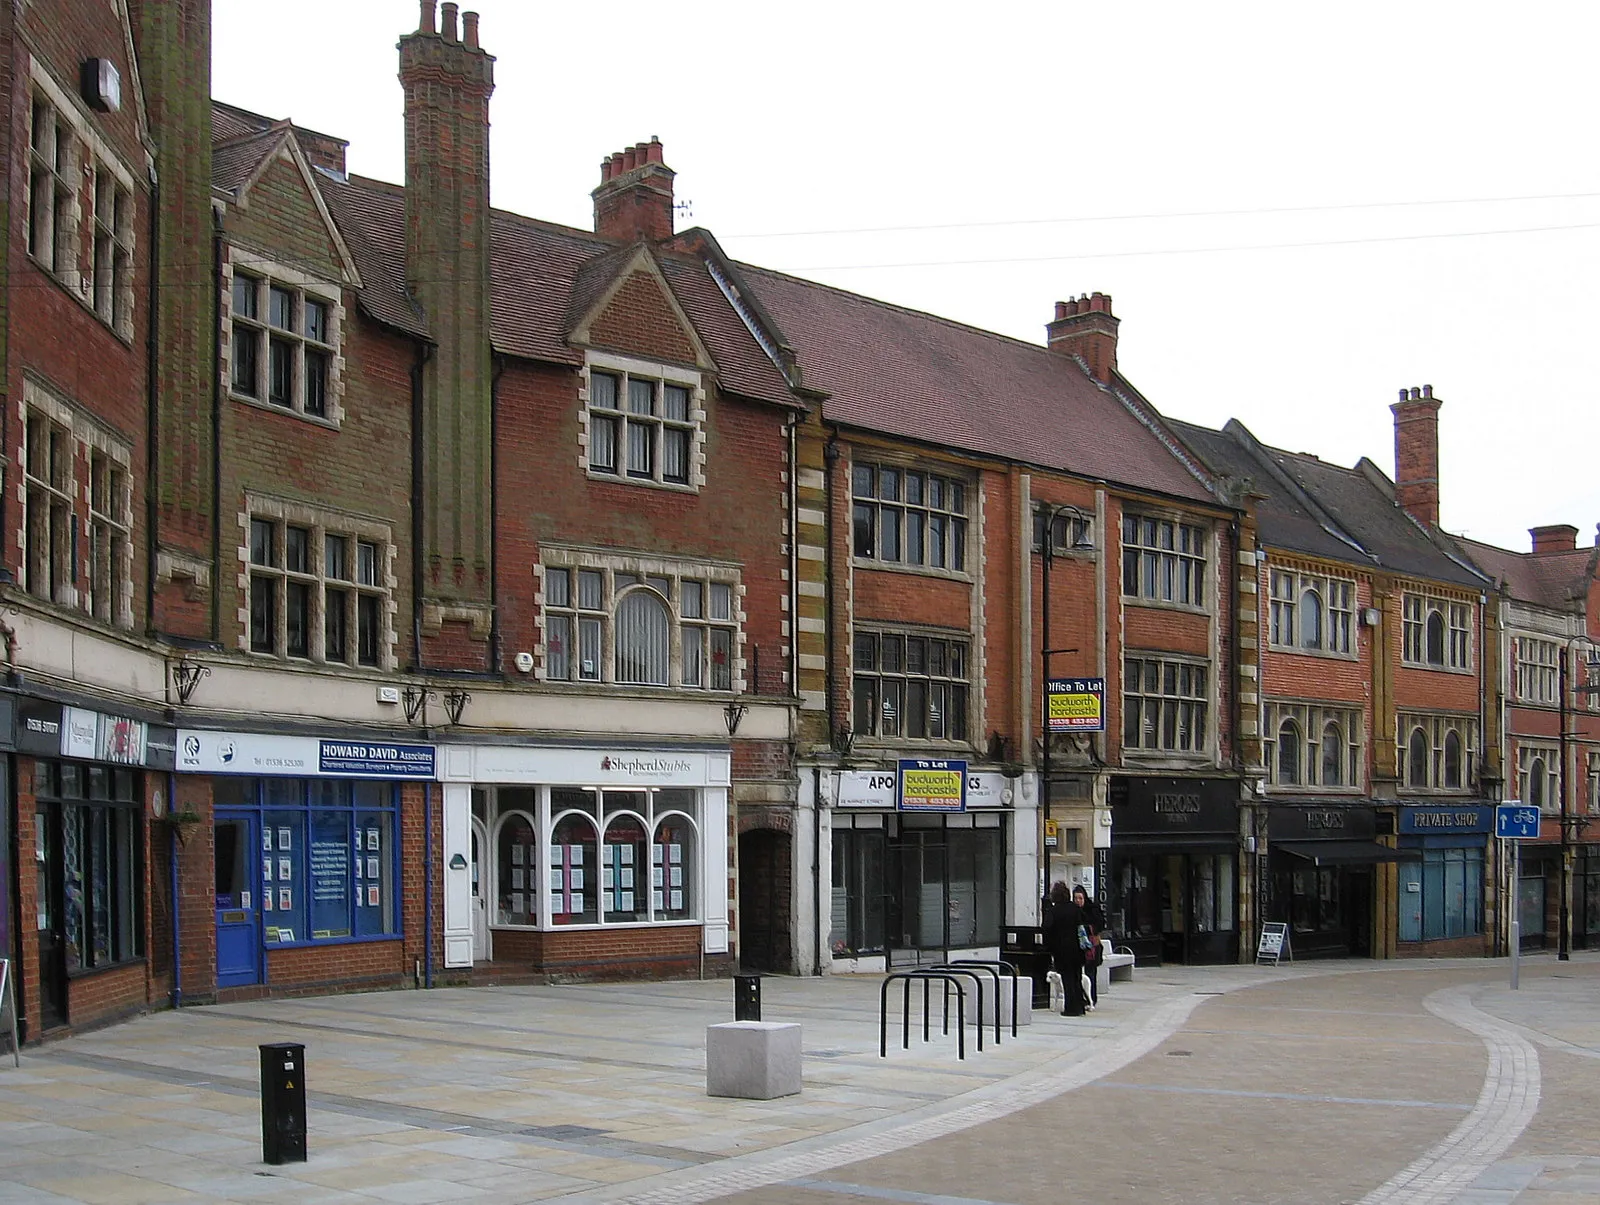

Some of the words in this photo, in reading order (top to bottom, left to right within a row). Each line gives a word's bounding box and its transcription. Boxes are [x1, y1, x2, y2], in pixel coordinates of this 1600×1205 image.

[1074, 682, 1085, 691] To
[1087, 681, 1102, 691] Let
[322, 744, 366, 758] HOWARD
[369, 747, 397, 759] DAVID
[399, 751, 432, 761] Associates
[906, 772, 954, 785] budworth
[906, 784, 958, 795] hardcastle
[1154, 793, 1201, 812] HEROES
[1305, 811, 1345, 829] HEROES
[1413, 812, 1452, 828] PRIVATE
[1455, 812, 1479, 827] SHOP
